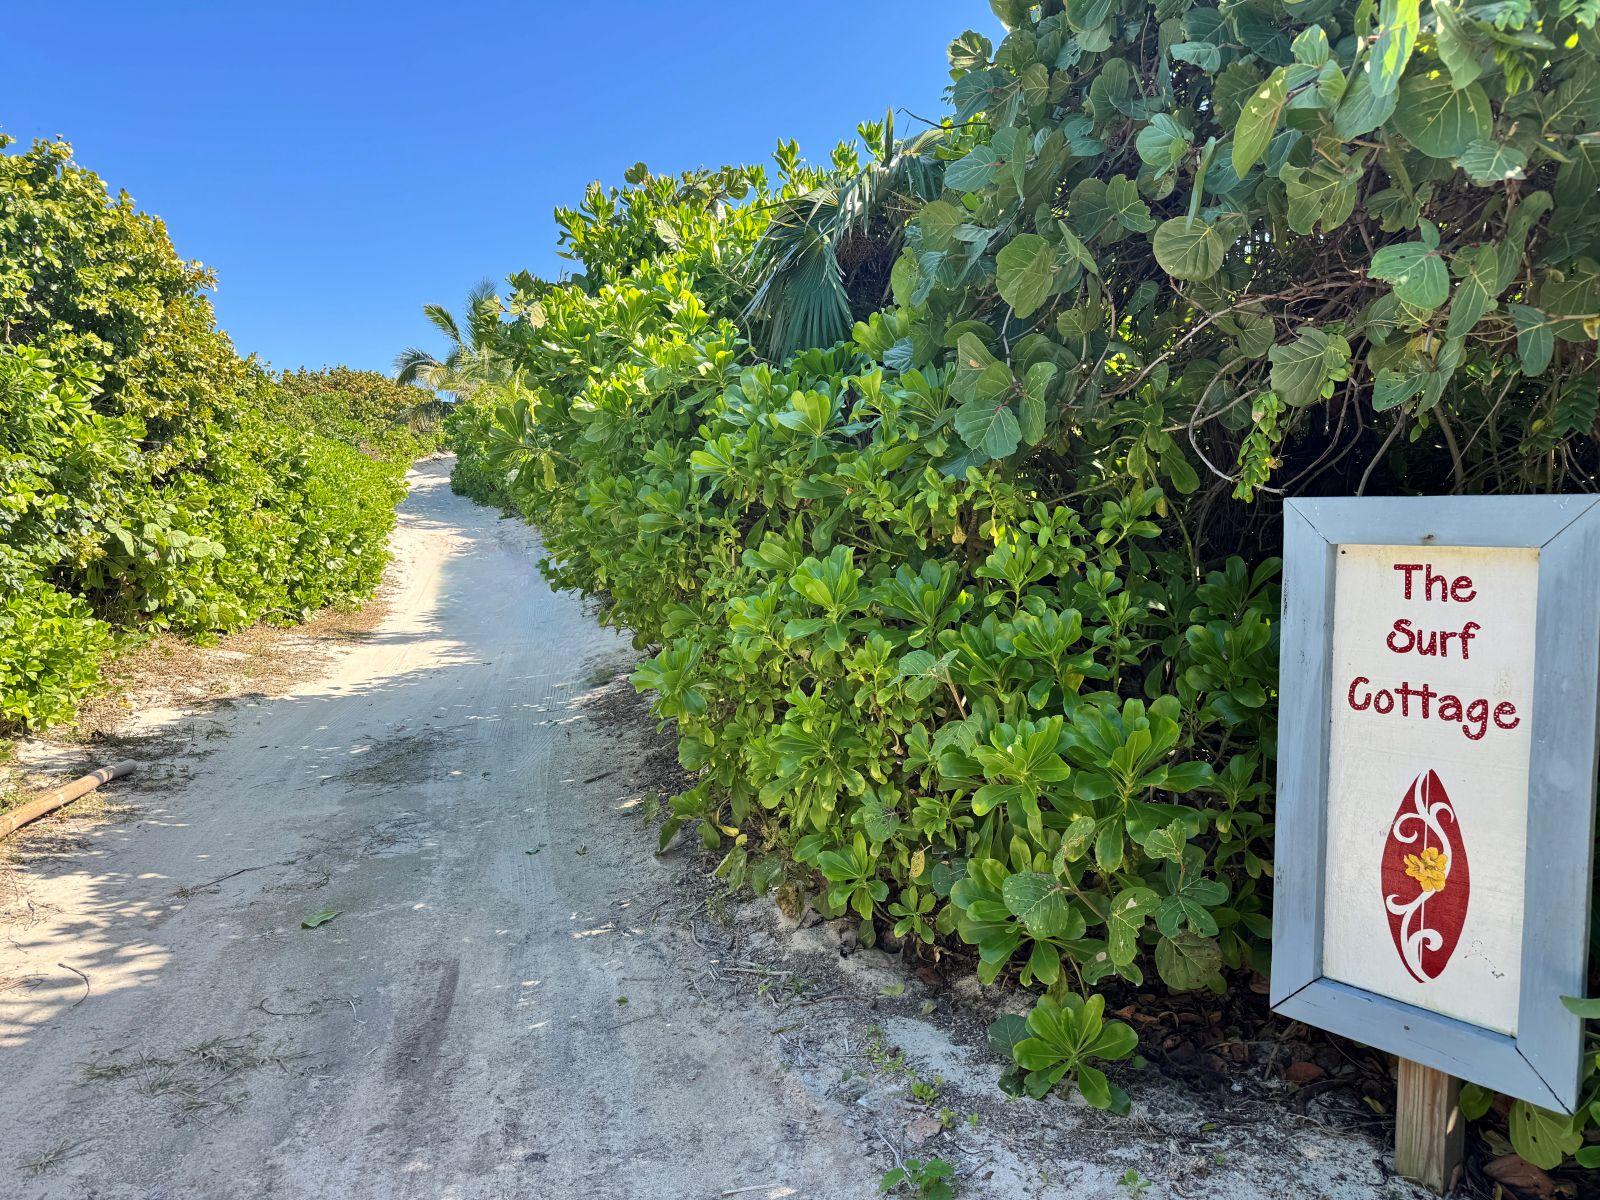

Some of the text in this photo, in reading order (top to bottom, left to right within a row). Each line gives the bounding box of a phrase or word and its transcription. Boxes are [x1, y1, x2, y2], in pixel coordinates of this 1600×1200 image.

[1393, 564, 1476, 602] The
[1386, 618, 1481, 660] Surf
[1348, 676, 1520, 741] Cottage
